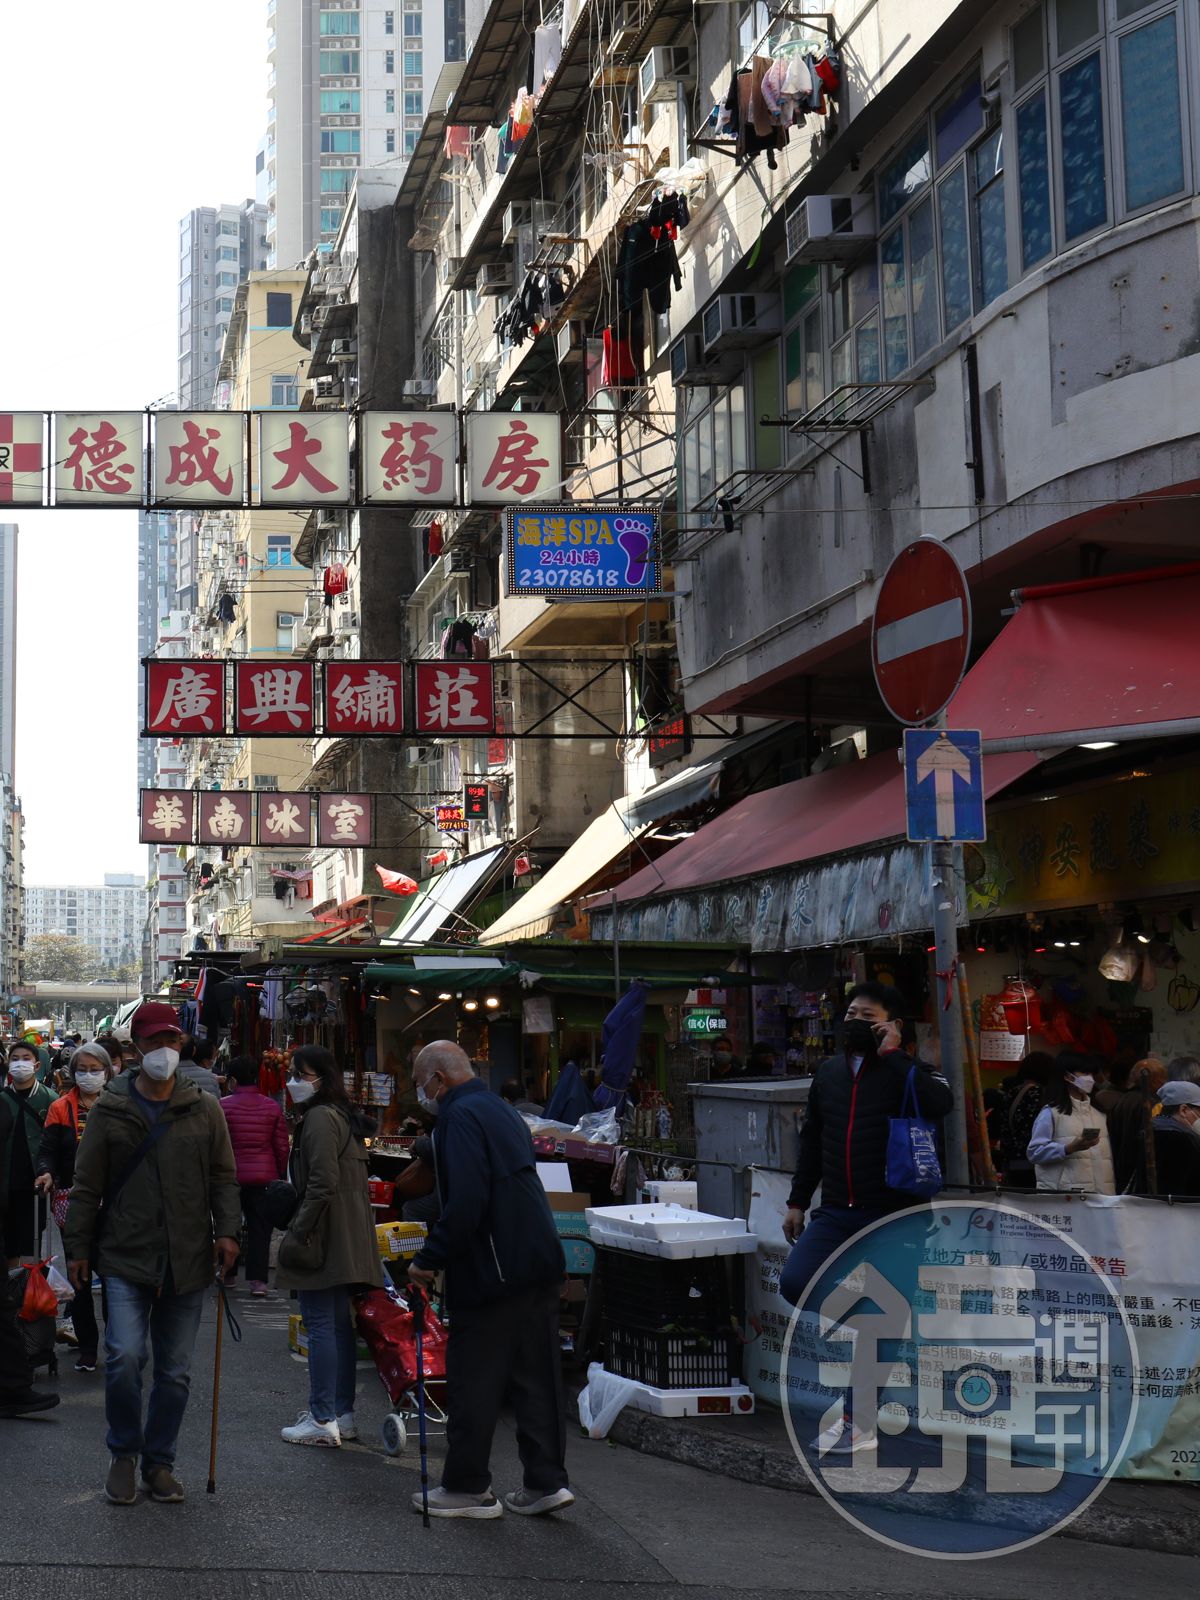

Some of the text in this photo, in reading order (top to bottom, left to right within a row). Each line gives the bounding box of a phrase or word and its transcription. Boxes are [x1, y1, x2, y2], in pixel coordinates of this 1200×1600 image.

[517, 517, 615, 547] 海洋SPA
[539, 549, 601, 567] 24小時
[518, 568, 620, 587] 23078618
[150, 666, 490, 731] 廣興繡莊
[147, 794, 365, 842] 華南冰室
[1171, 1450, 1200, 1463] 202
